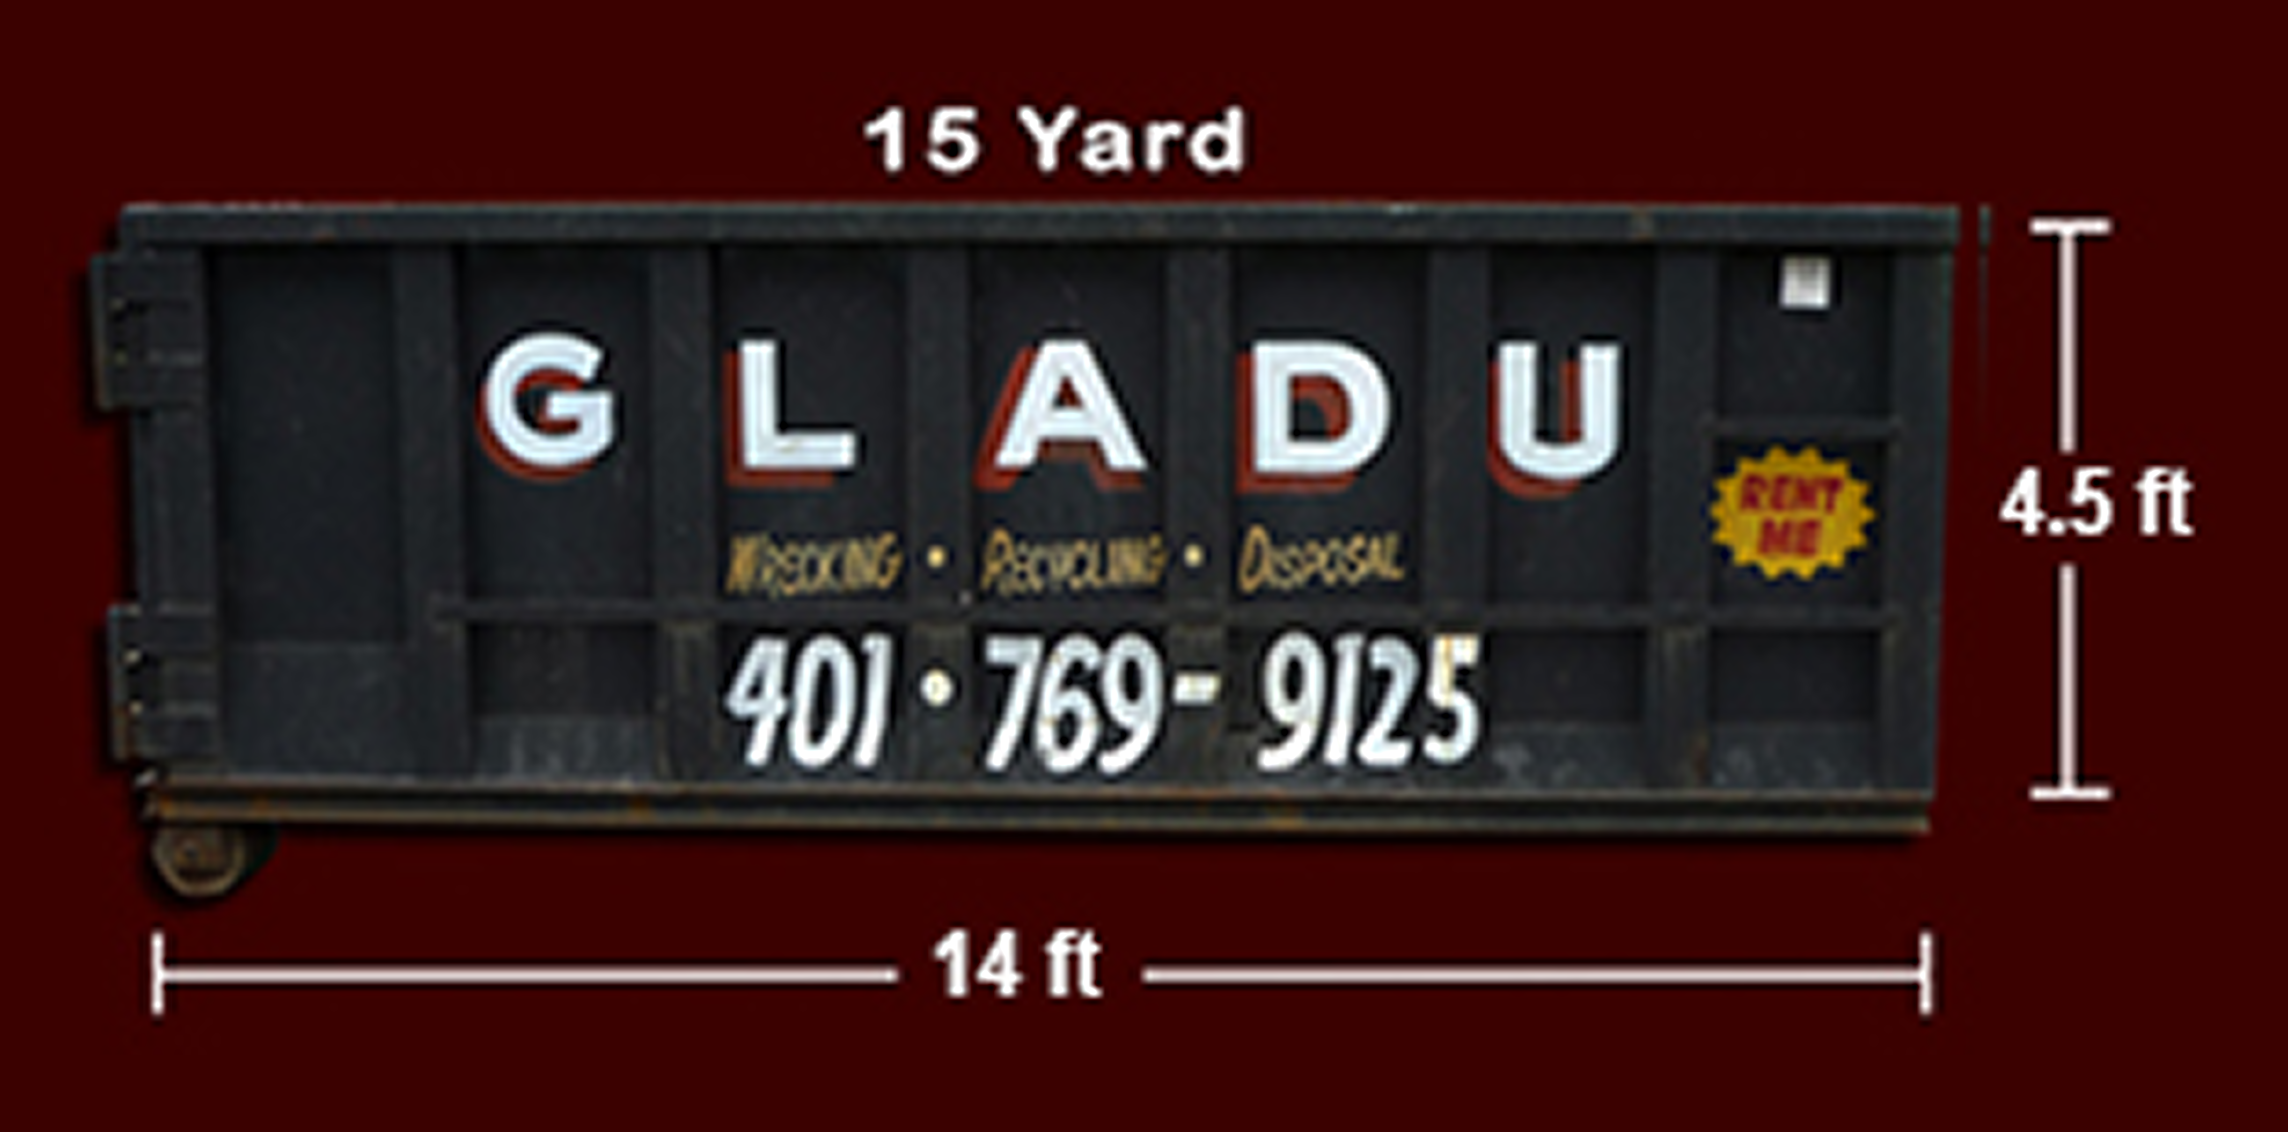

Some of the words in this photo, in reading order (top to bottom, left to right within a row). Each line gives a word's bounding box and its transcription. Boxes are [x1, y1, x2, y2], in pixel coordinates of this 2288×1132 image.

[476, 333, 1620, 497] GLADU
[1739, 473, 1844, 515] RENT
[1756, 518, 1824, 558] ME
